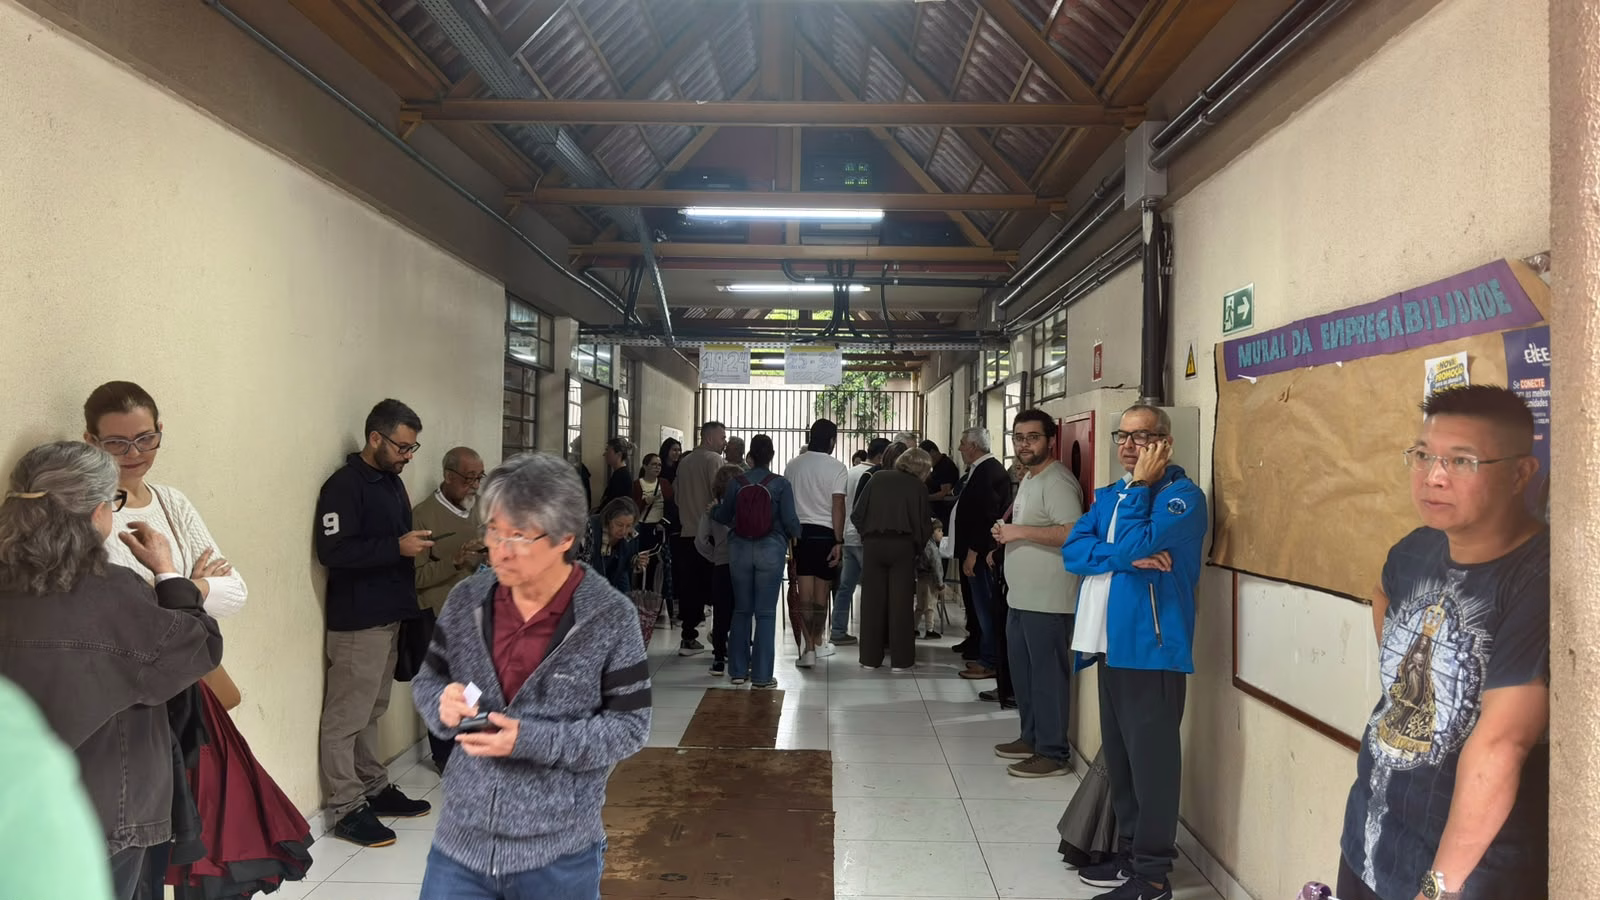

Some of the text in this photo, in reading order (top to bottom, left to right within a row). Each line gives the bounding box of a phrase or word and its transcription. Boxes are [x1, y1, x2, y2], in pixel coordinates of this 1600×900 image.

[1238, 333, 1287, 369] MURAL
[1291, 327, 1313, 357] DA
[1512, 377, 1545, 390] Se CONECTE
[322, 512, 340, 536] 9
